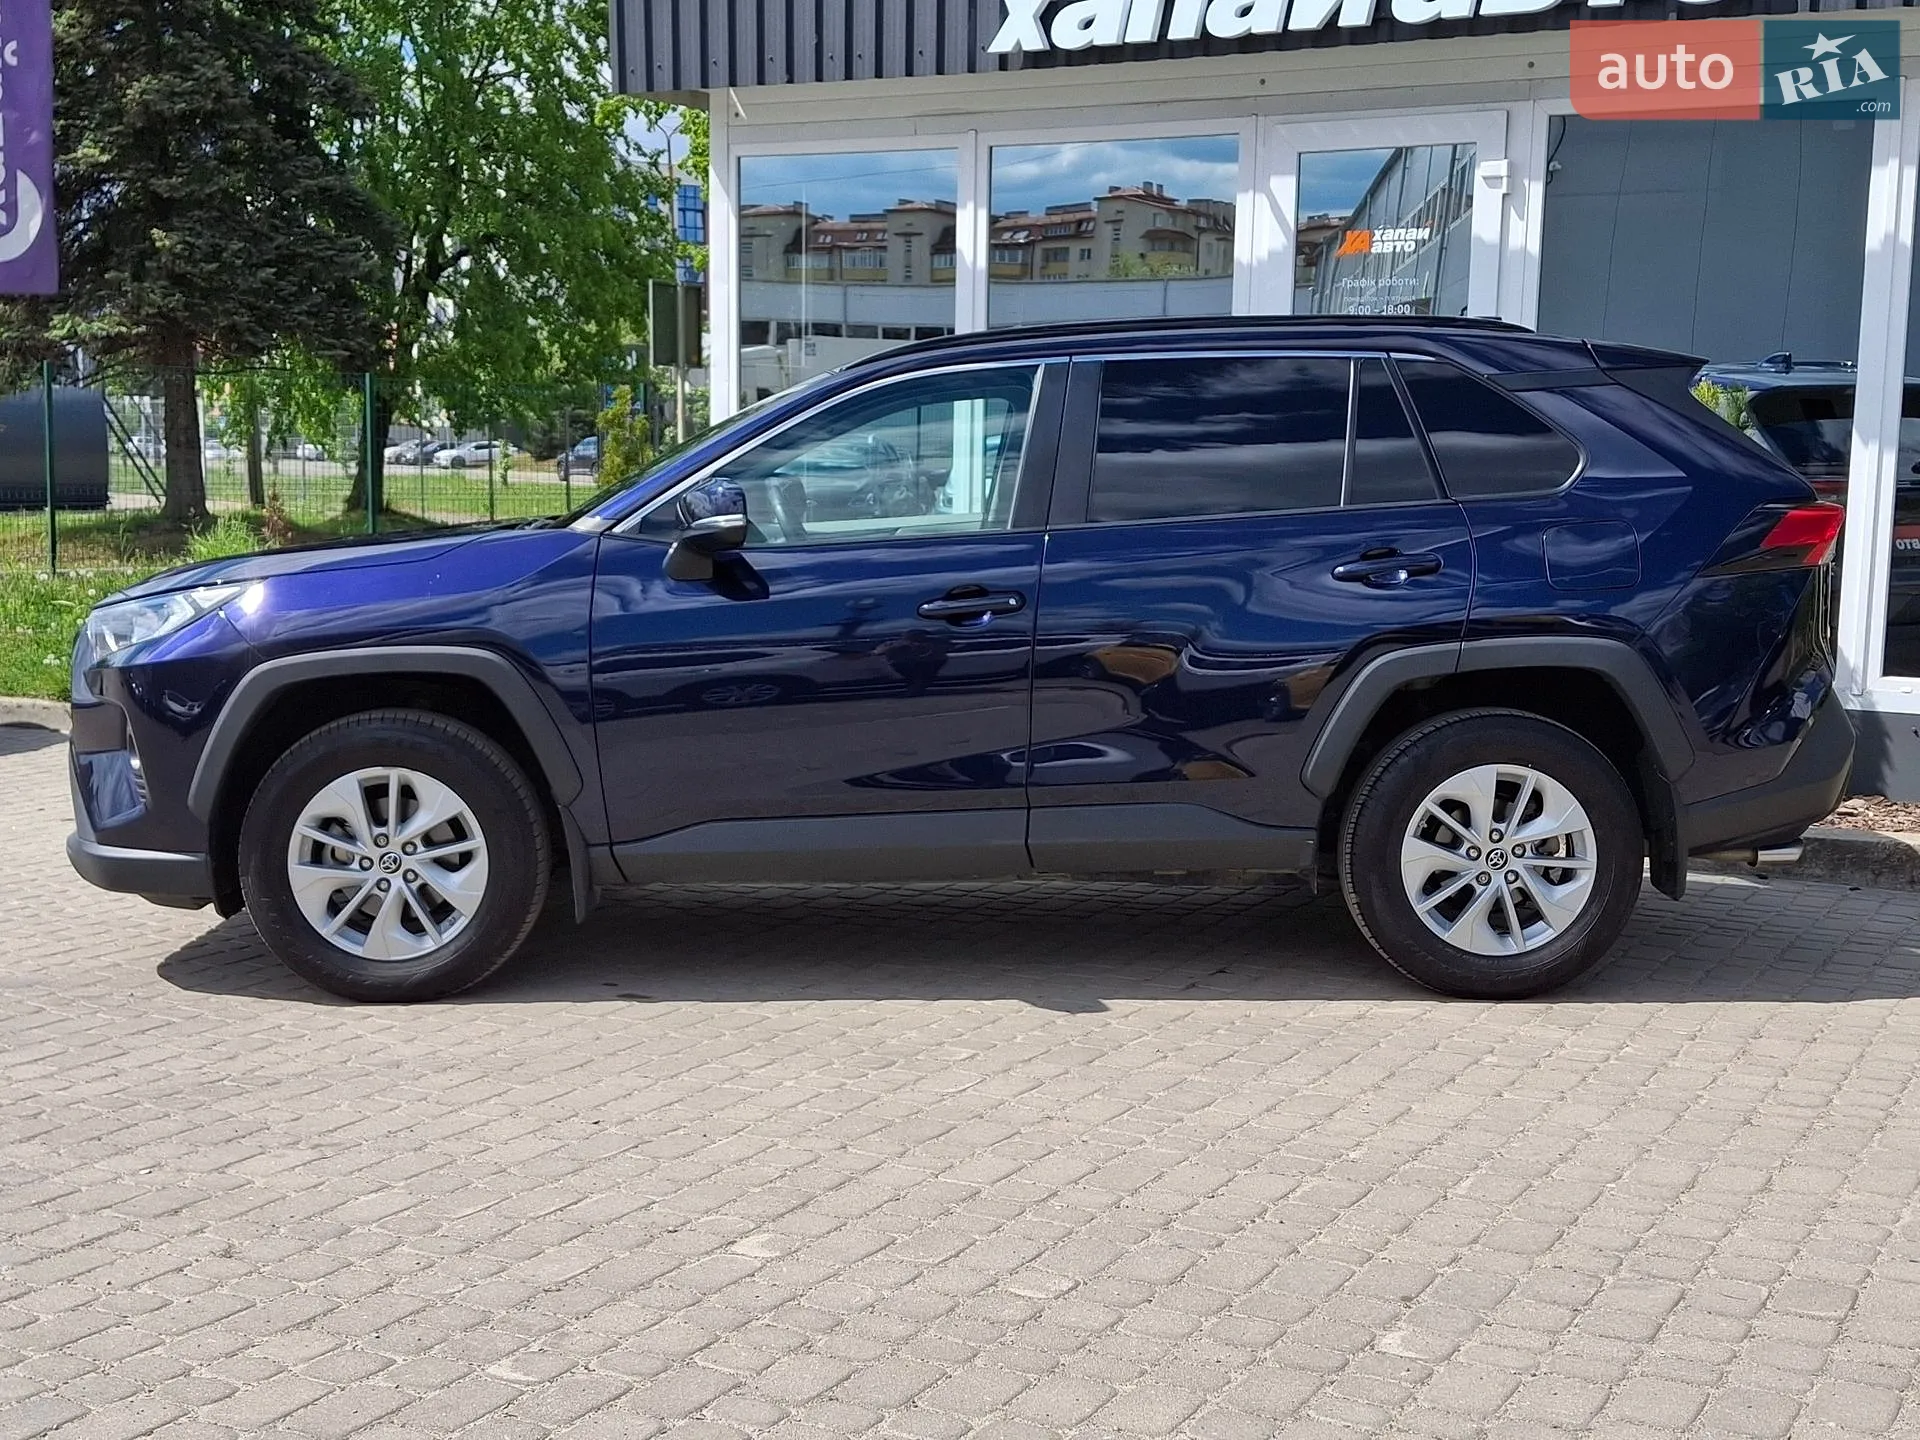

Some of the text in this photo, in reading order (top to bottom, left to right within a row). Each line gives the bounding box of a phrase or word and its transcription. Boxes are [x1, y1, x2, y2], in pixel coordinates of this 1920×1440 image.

[1372, 226, 1431, 240] хапай
[1370, 240, 1416, 253] авто
[1342, 277, 1376, 290] Графік
[1379, 276, 1419, 288] роботи:
[1348, 305, 1372, 315] 9:00
[1383, 304, 1411, 315] 18:00
